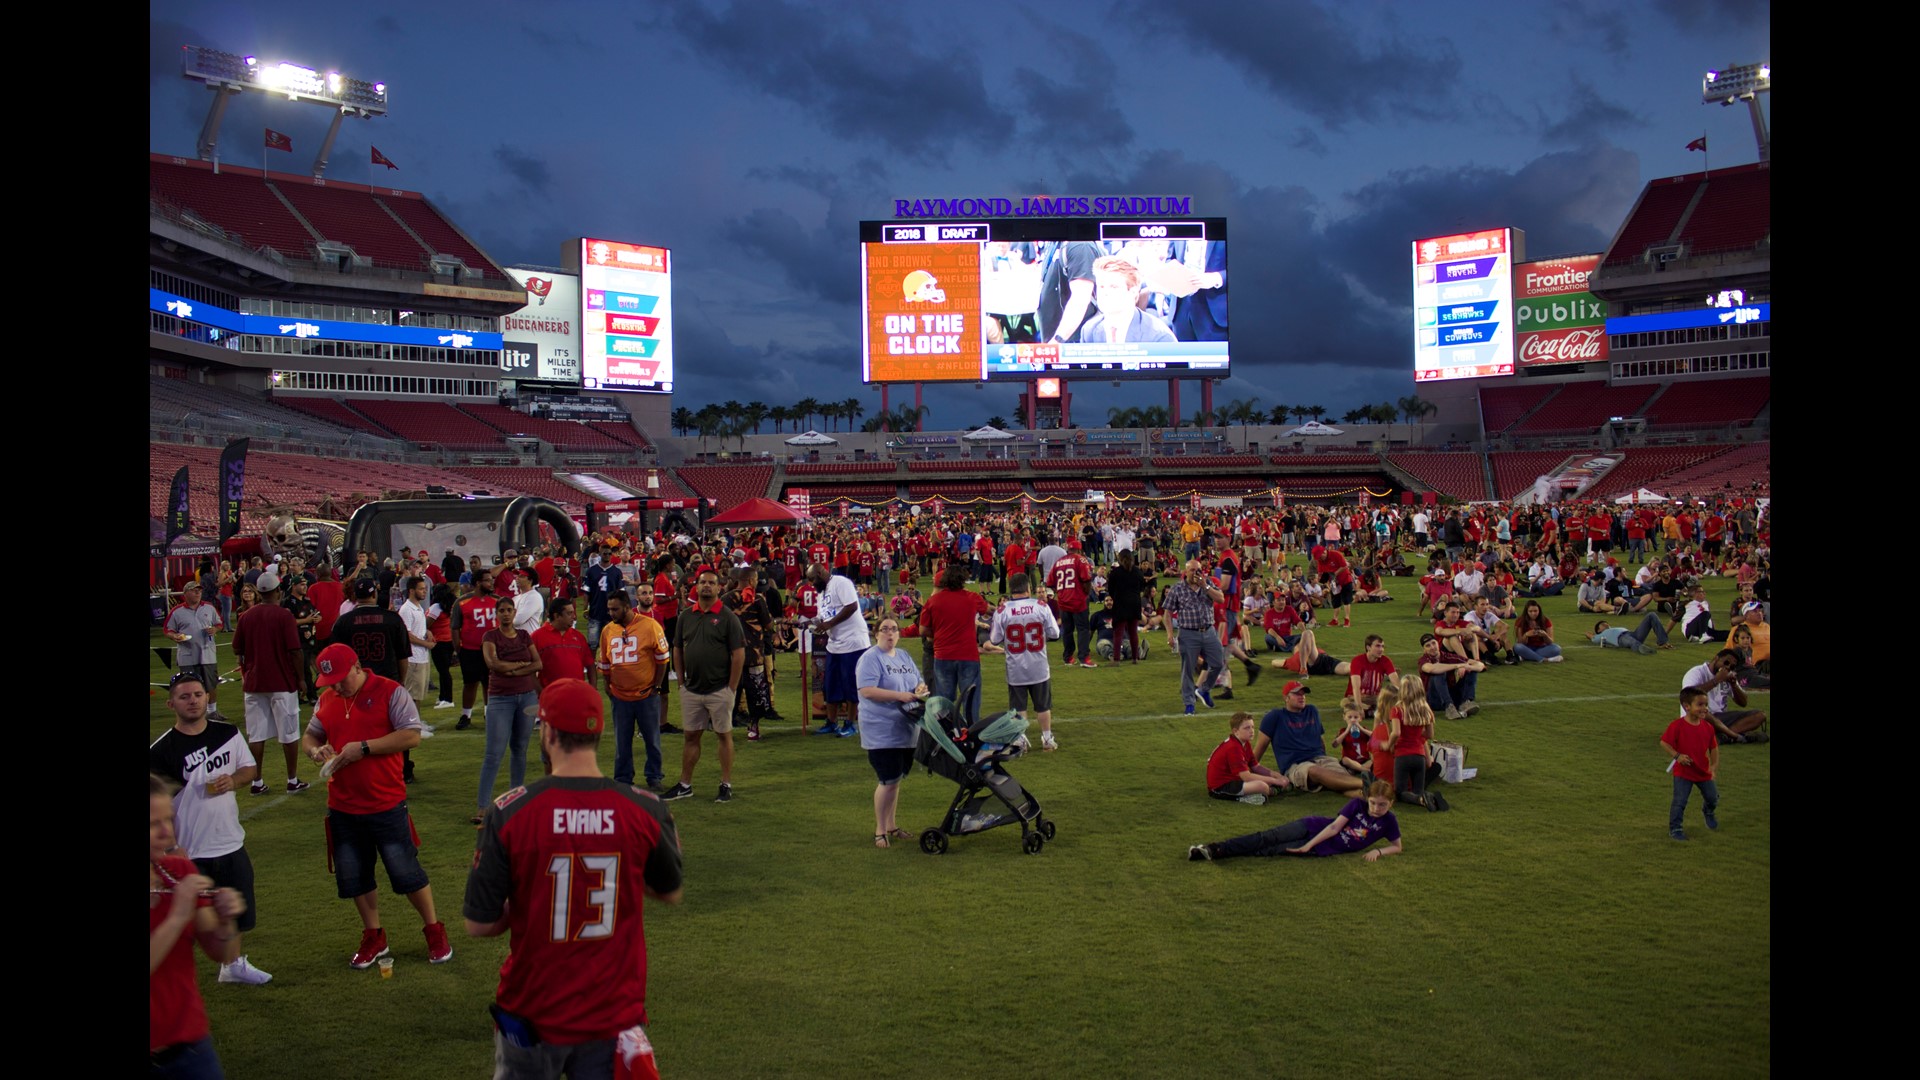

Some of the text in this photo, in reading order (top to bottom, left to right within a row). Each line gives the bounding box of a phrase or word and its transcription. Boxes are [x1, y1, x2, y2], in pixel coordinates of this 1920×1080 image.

[895, 197, 1191, 217] RAYMOND JAMES STADIUM
[894, 228, 978, 240] 2018 DRAFT
[1139, 226, 1168, 237] 0:00
[1447, 268, 1478, 278] RAVENS
[1526, 269, 1593, 288] Frontier
[1527, 283, 1590, 295] COMMUNICATIONS
[1442, 310, 1485, 321] SEAHAWKS
[1517, 299, 1601, 325] Publix
[885, 314, 964, 334] ON THE
[888, 335, 961, 355] CLOCK
[1445, 332, 1483, 342] COWBOYS
[1519, 329, 1606, 362] Coca-Cola
[547, 358, 577, 367] MILLER
[554, 348, 569, 357] IT'S
[552, 368, 572, 377] TIME
[228, 501, 238, 524] FLZ
[598, 575, 608, 592] 4
[1056, 568, 1076, 590] 22
[473, 607, 497, 628] 54
[1011, 606, 1034, 616] McCOY
[1006, 622, 1045, 654] 93
[610, 636, 638, 664] 22
[184, 746, 208, 770] JUST
[553, 808, 615, 835] EVANS
[546, 852, 621, 943] 13
